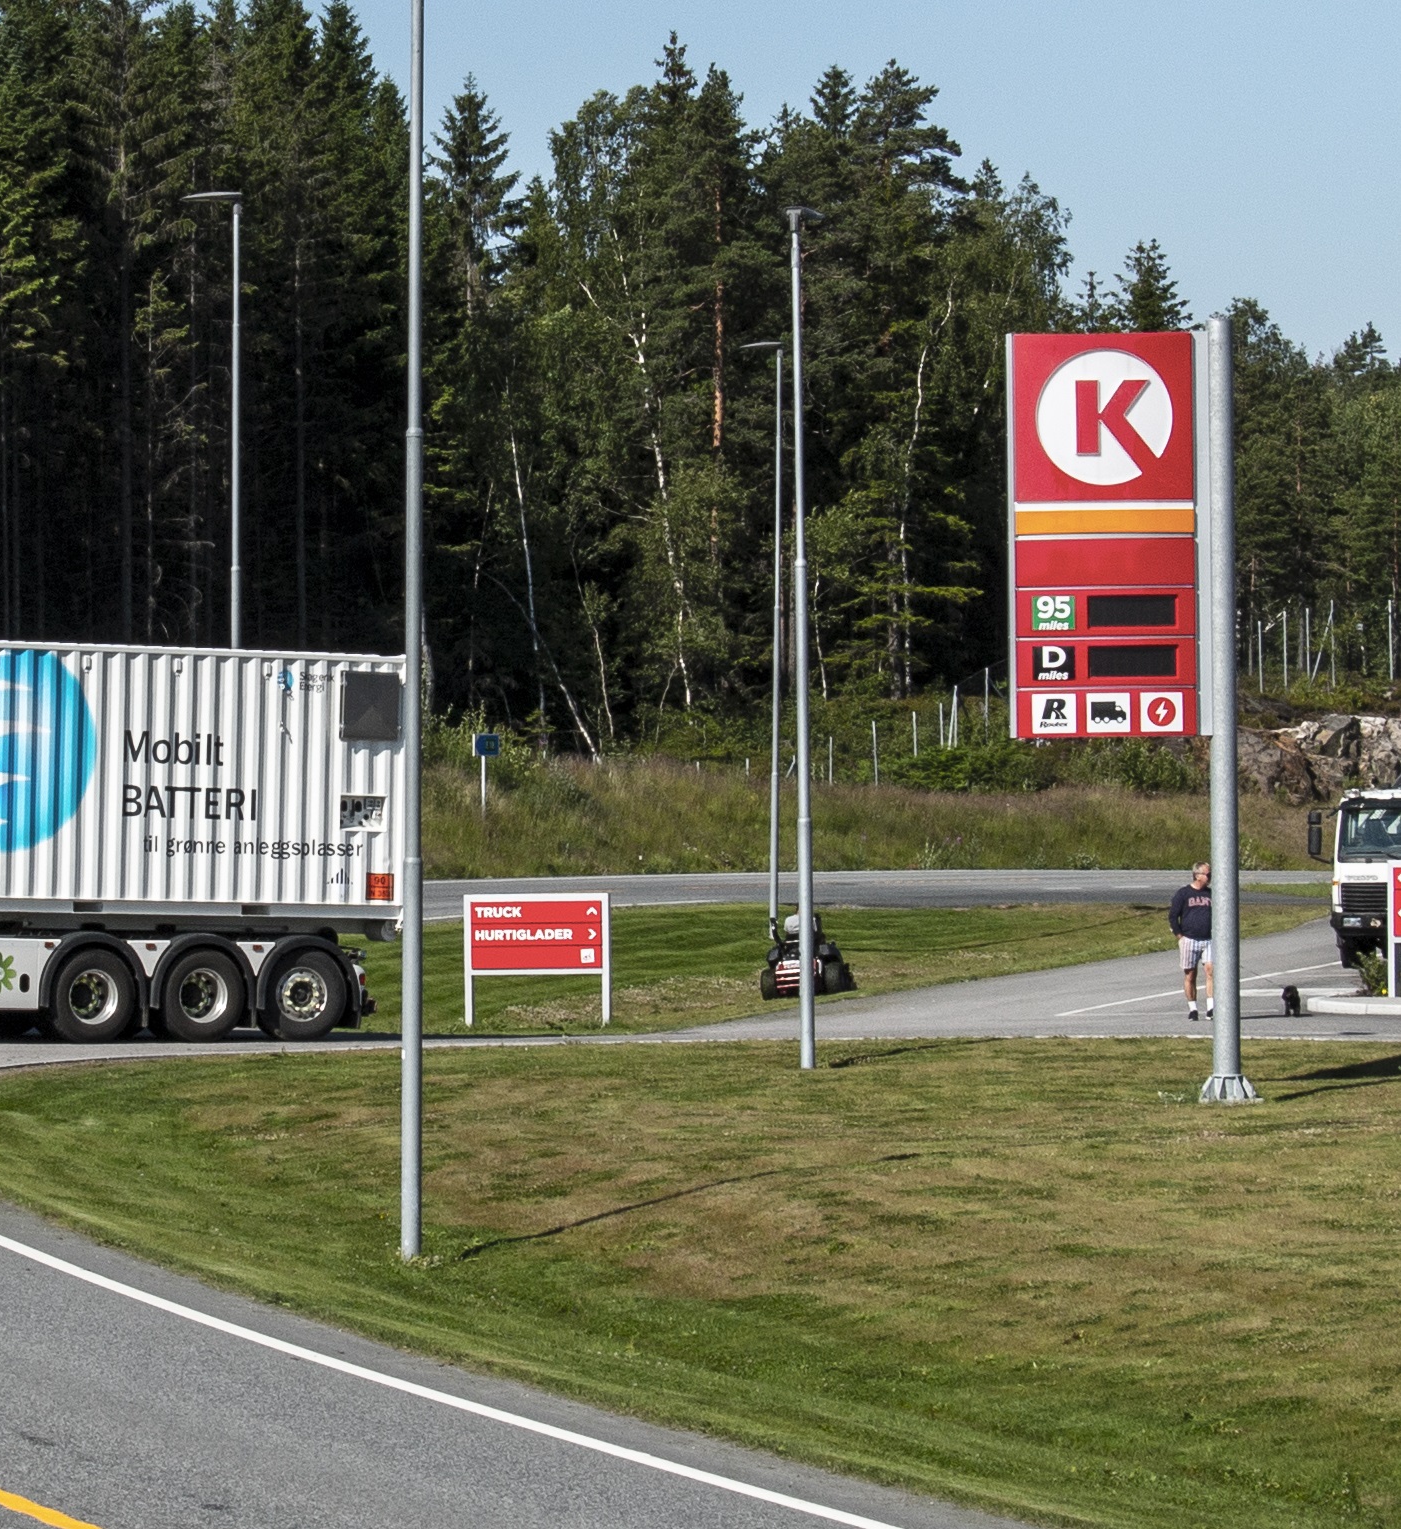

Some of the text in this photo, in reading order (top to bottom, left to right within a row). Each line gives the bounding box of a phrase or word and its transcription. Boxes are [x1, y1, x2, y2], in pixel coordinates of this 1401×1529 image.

[1036, 595, 1071, 619] 95
[1038, 620, 1069, 631] miles
[1042, 645, 1067, 669] D
[1038, 670, 1069, 680] miles
[123, 729, 224, 766] Mobilt
[122, 784, 257, 820] BATTERI
[143, 835, 364, 860] til grønne anleggsplasser
[474, 906, 522, 918] TRUCK
[474, 928, 573, 941] HURTIGLADER
